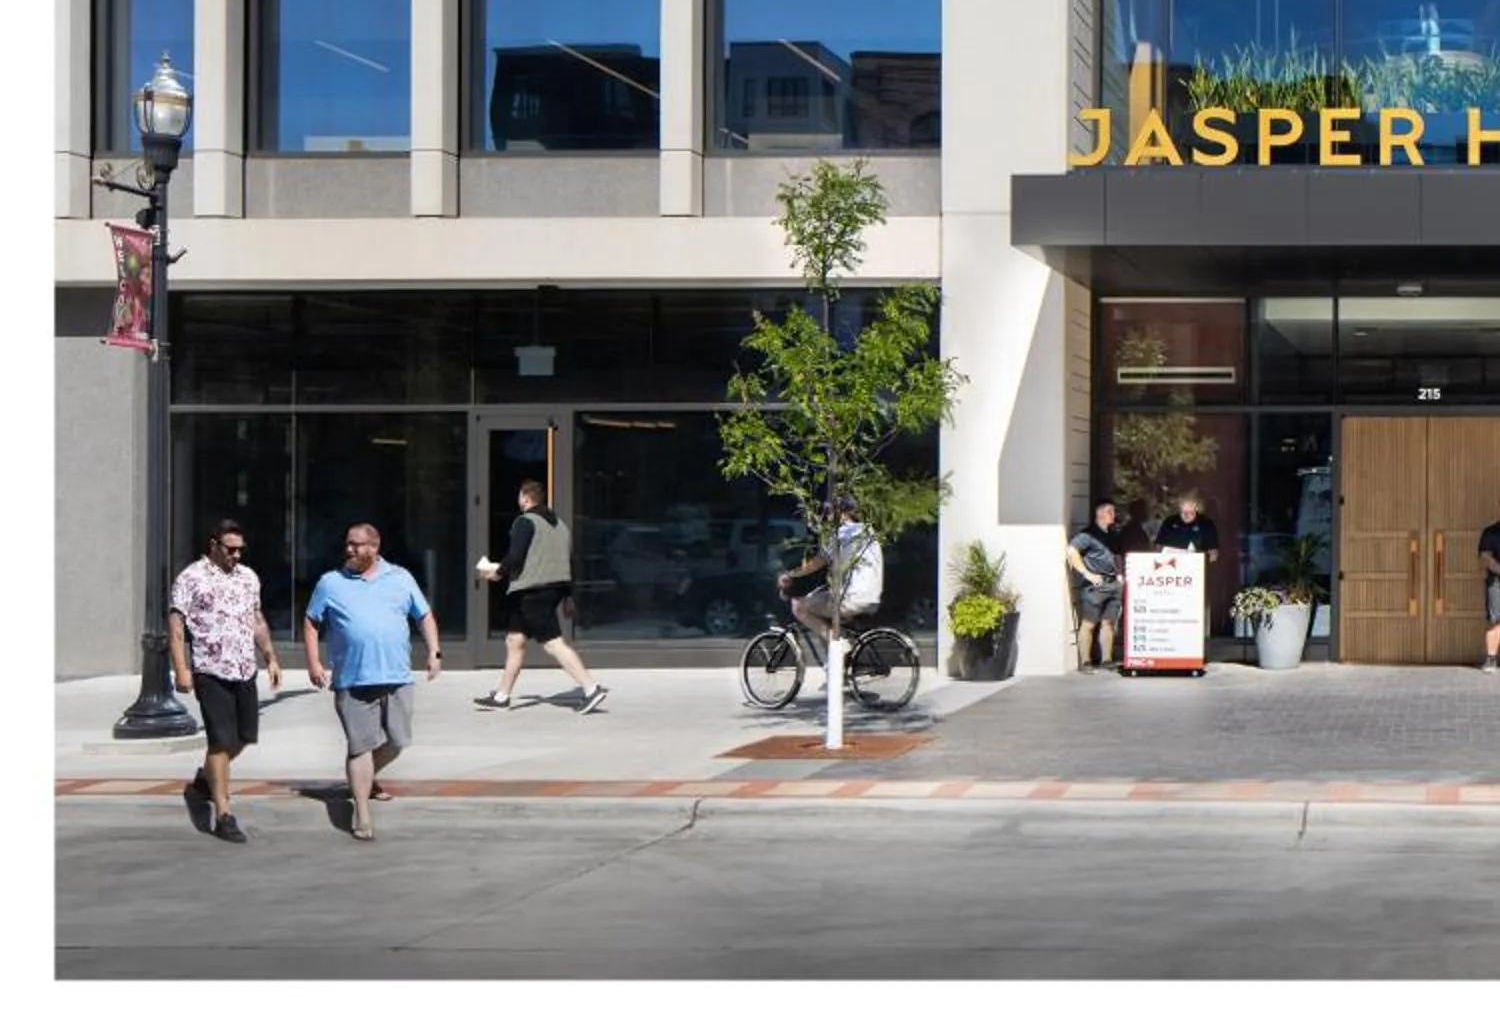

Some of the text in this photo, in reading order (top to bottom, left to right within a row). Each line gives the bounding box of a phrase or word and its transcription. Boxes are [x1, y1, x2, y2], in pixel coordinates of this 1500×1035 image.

[1067, 107, 1425, 166] JASPER
[1417, 387, 1442, 401] 215
[1137, 575, 1193, 587] JASPER
